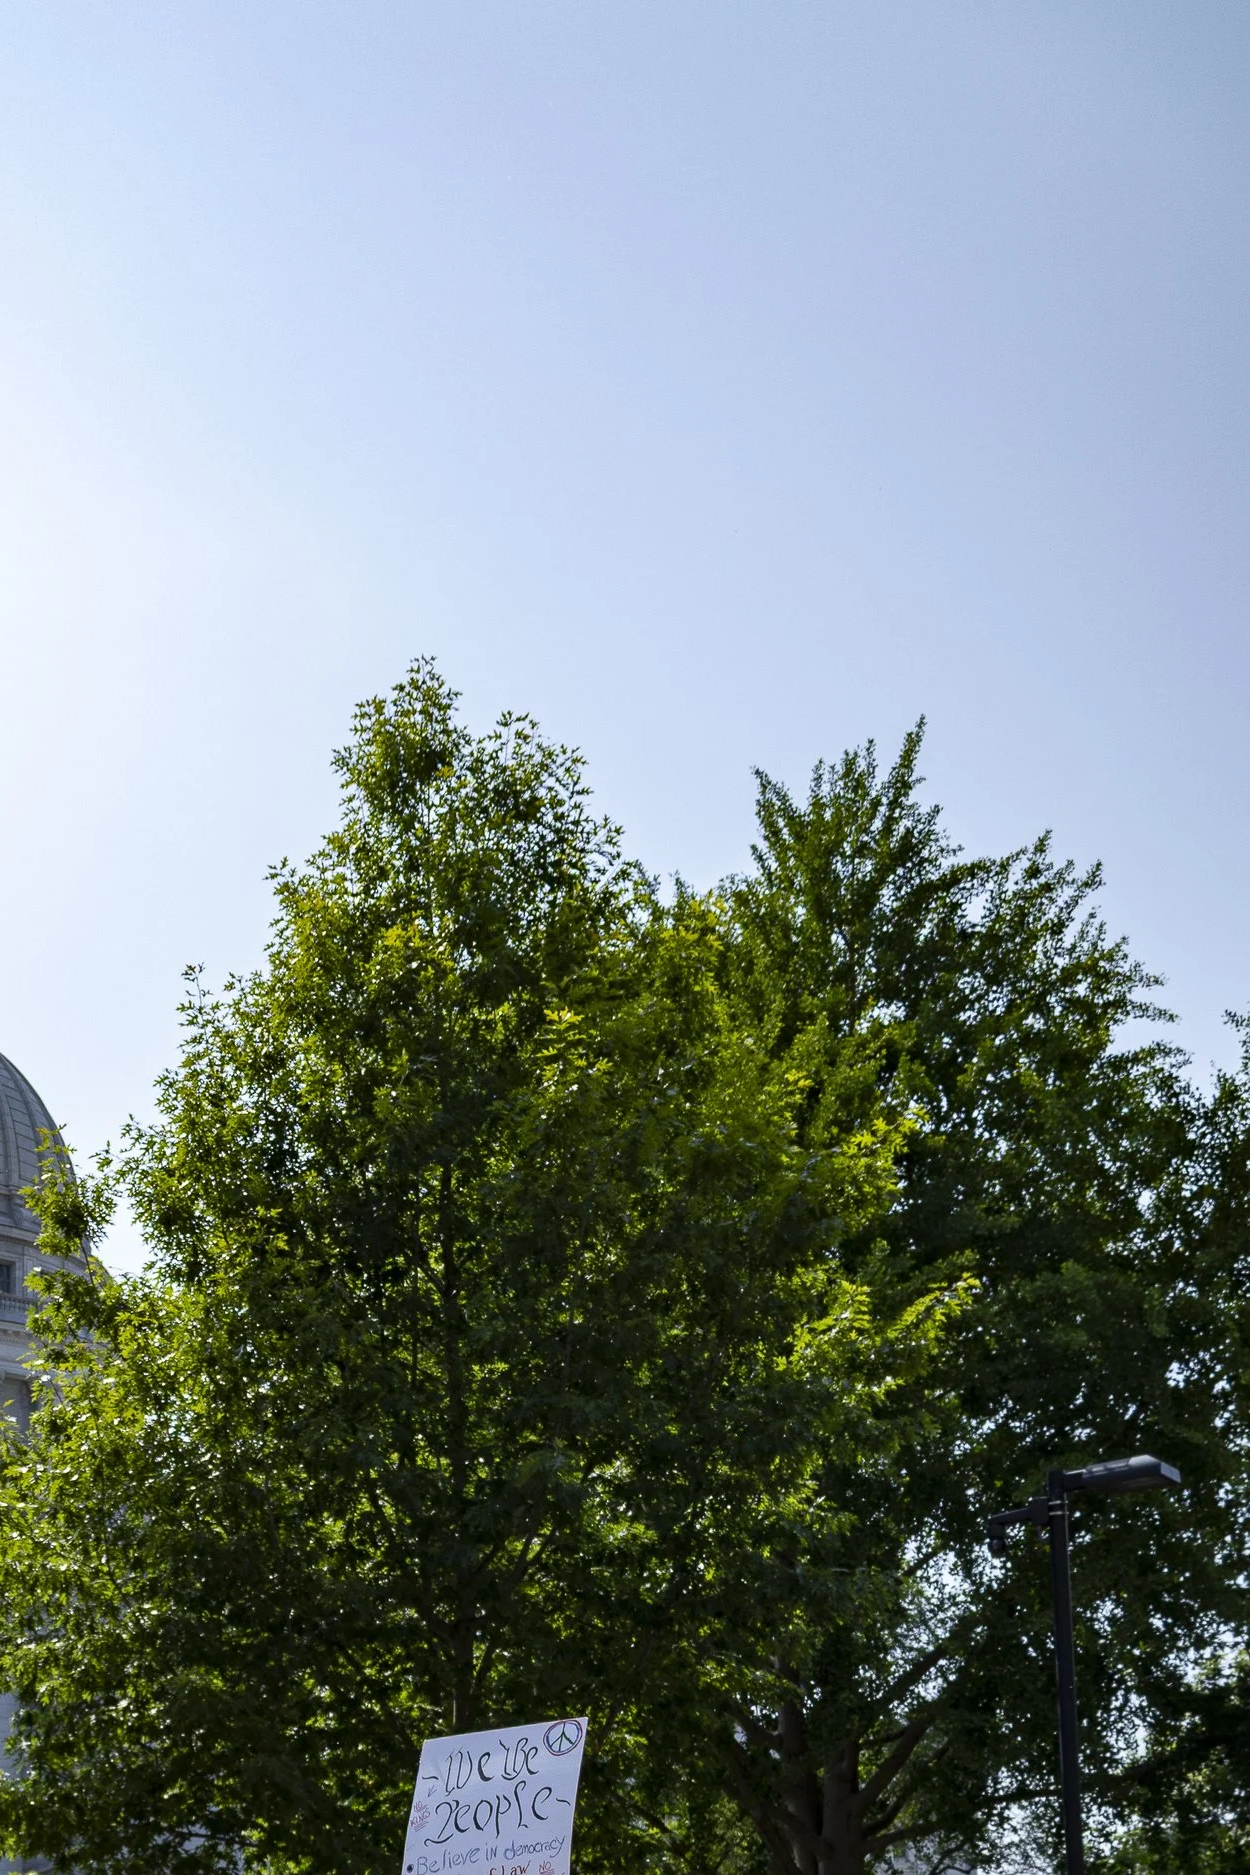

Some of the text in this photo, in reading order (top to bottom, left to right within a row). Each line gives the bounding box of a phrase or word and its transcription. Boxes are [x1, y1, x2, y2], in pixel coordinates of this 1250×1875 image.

[445, 1747, 495, 1796] We
[424, 1780, 553, 1847] People
[416, 1847, 481, 1875] Believe
[504, 1835, 566, 1860] democracy
[539, 1861, 551, 1873] NO
